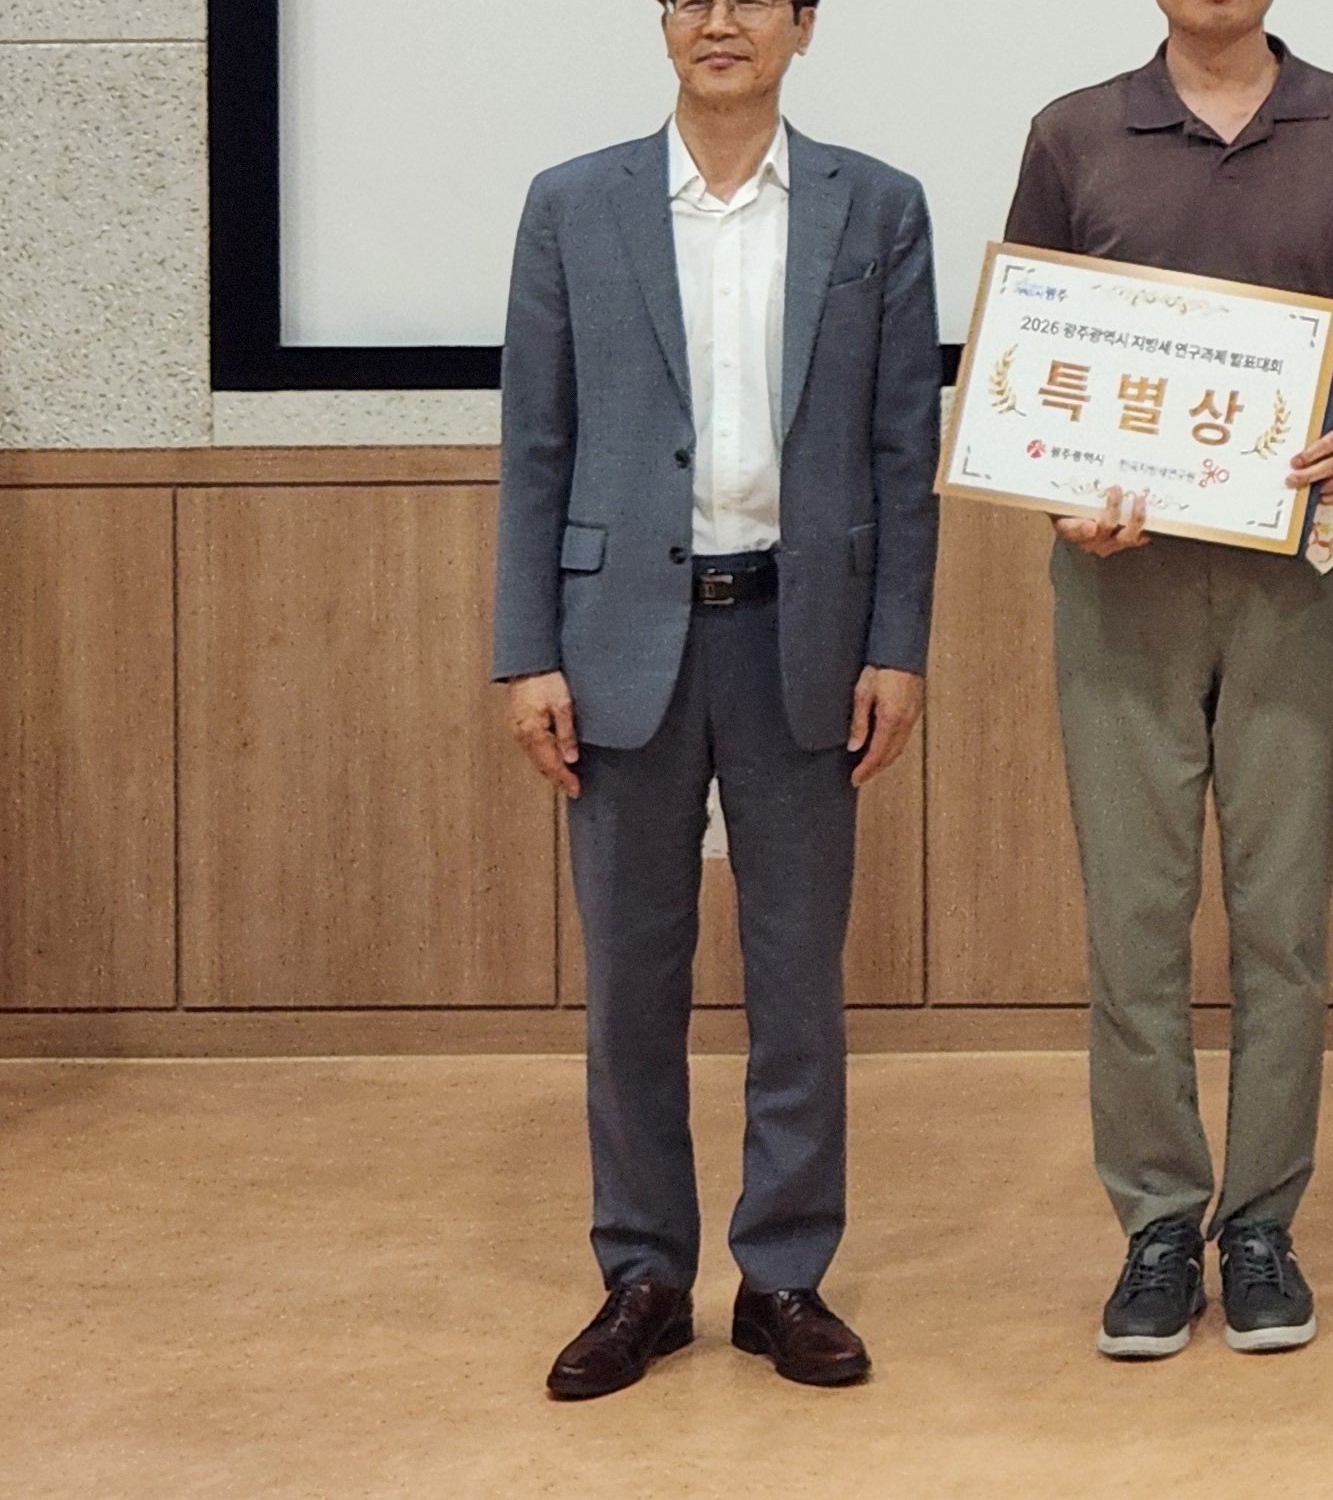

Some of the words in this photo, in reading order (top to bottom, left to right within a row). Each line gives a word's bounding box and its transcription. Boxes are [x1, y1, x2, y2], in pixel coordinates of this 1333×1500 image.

[1020, 316, 1060, 335] 2026
[1063, 323, 1129, 348] 광주광역시
[1131, 335, 1173, 356] 지방세
[1175, 343, 1228, 365] 연구과제
[1230, 353, 1283, 375] 발표대회
